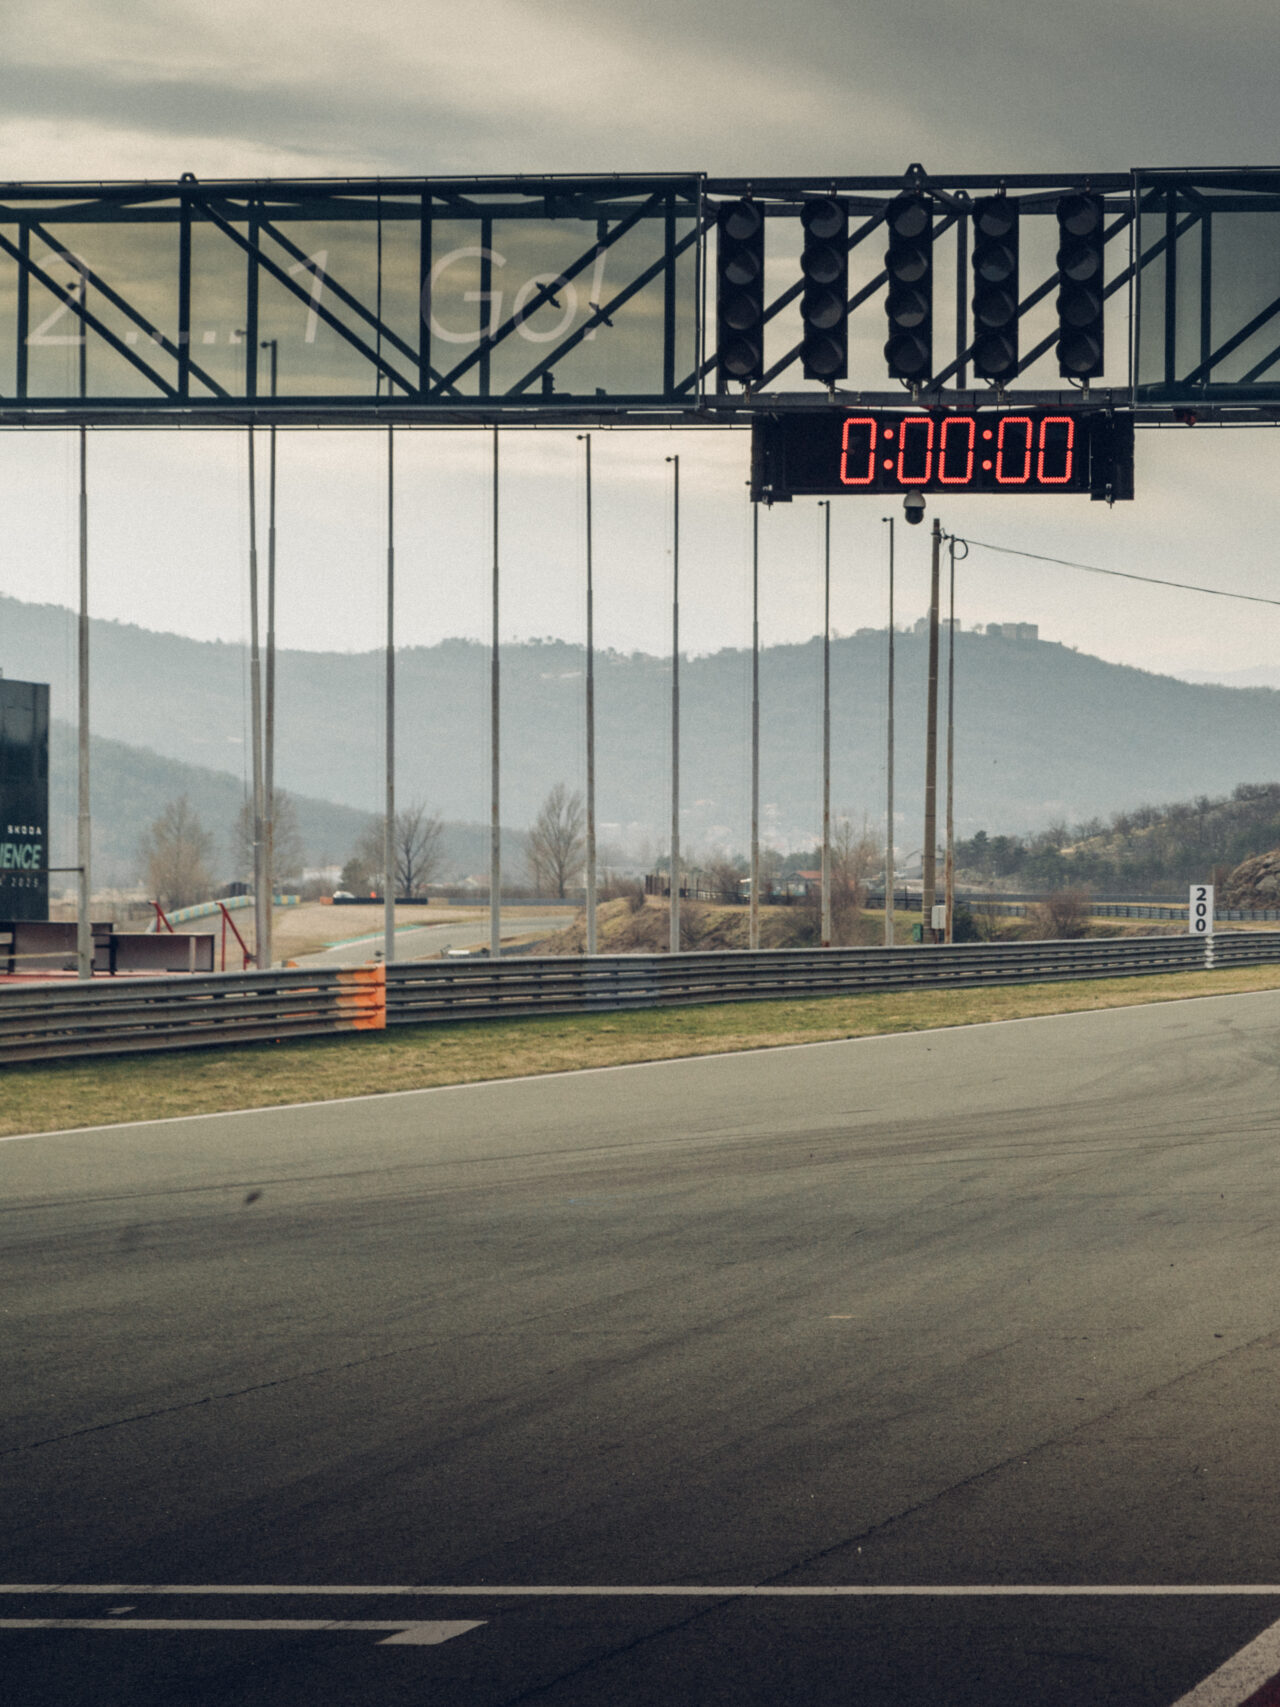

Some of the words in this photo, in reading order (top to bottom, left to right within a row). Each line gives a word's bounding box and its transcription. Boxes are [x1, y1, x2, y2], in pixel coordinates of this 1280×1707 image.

[288, 249, 328, 343] 1
[420, 246, 608, 343] Go!
[840, 416, 1074, 485] 0:00:00
[1195, 887, 1207, 932] 200
